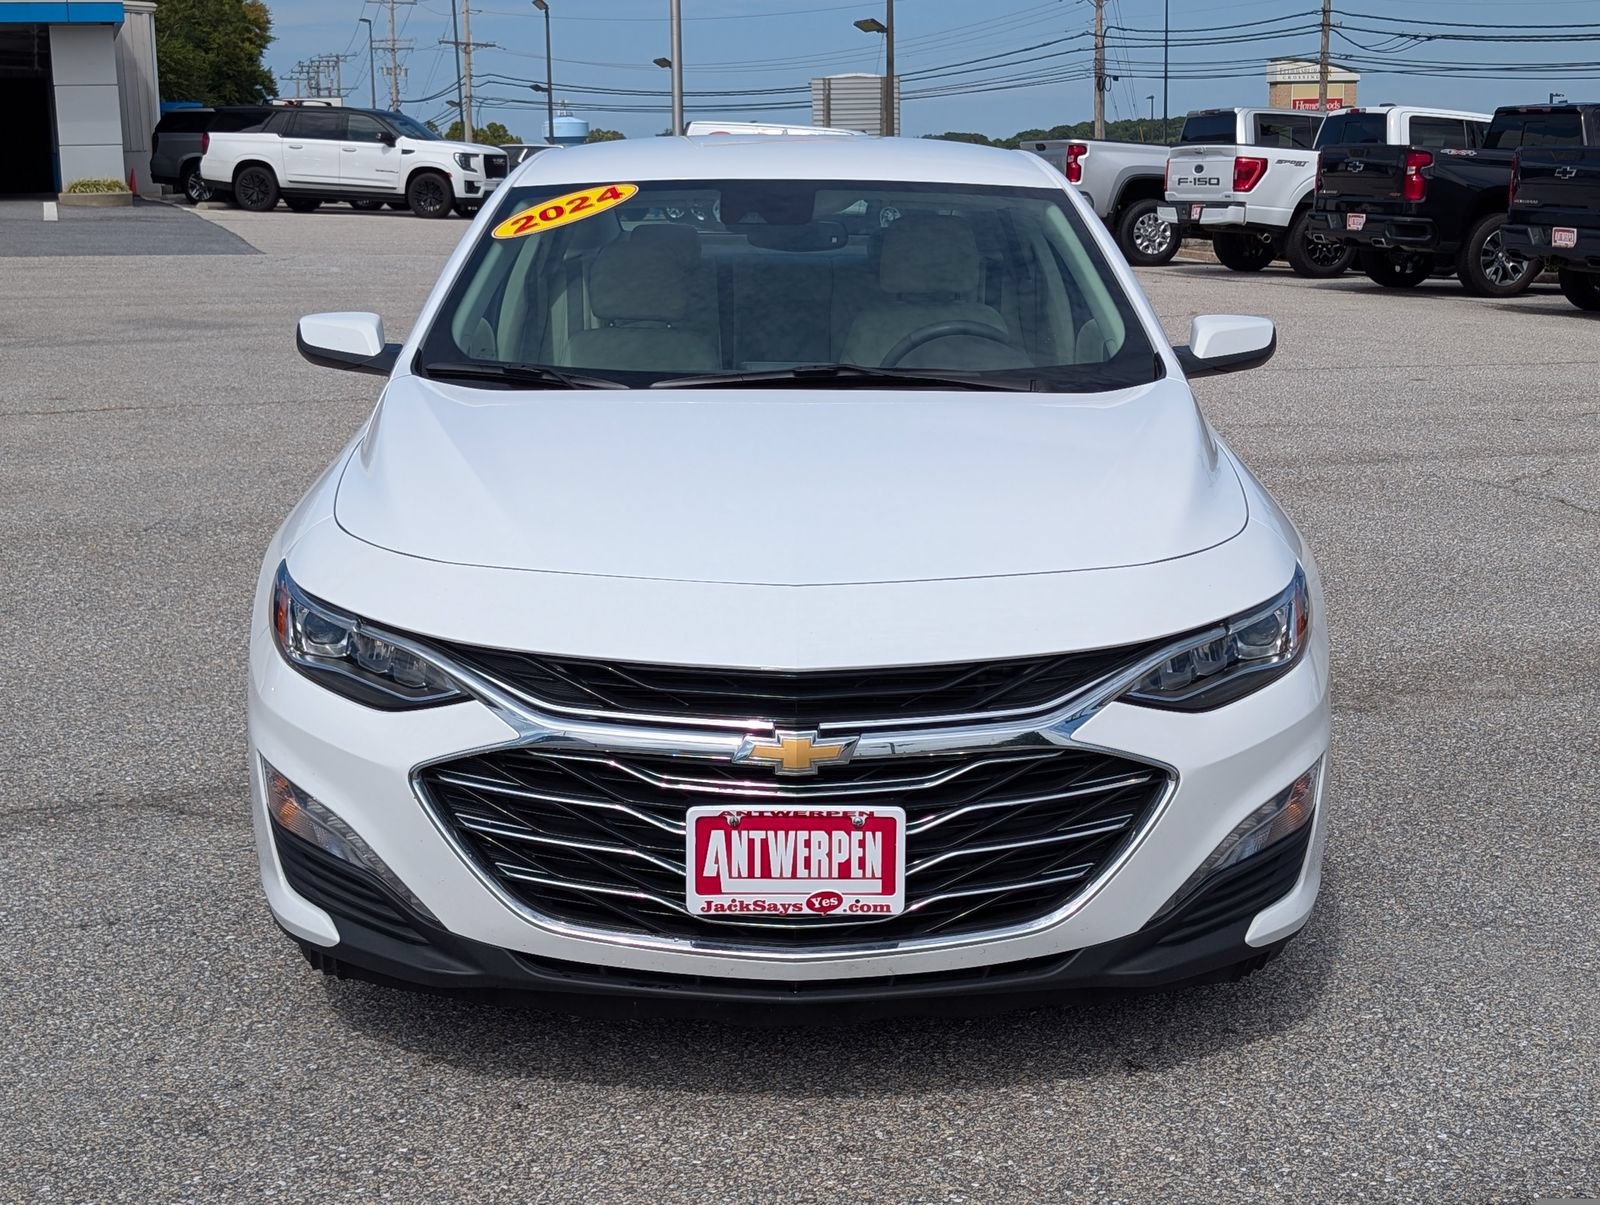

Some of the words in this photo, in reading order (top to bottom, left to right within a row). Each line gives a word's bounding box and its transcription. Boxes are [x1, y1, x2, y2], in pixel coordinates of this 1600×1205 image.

[1275, 159, 1309, 167] SPORT
[1177, 177, 1220, 186] F-150
[511, 186, 626, 235] 2024
[703, 829, 883, 879] ANTWERPEN
[700, 898, 804, 916] JackSays
[810, 894, 839, 908] Yes
